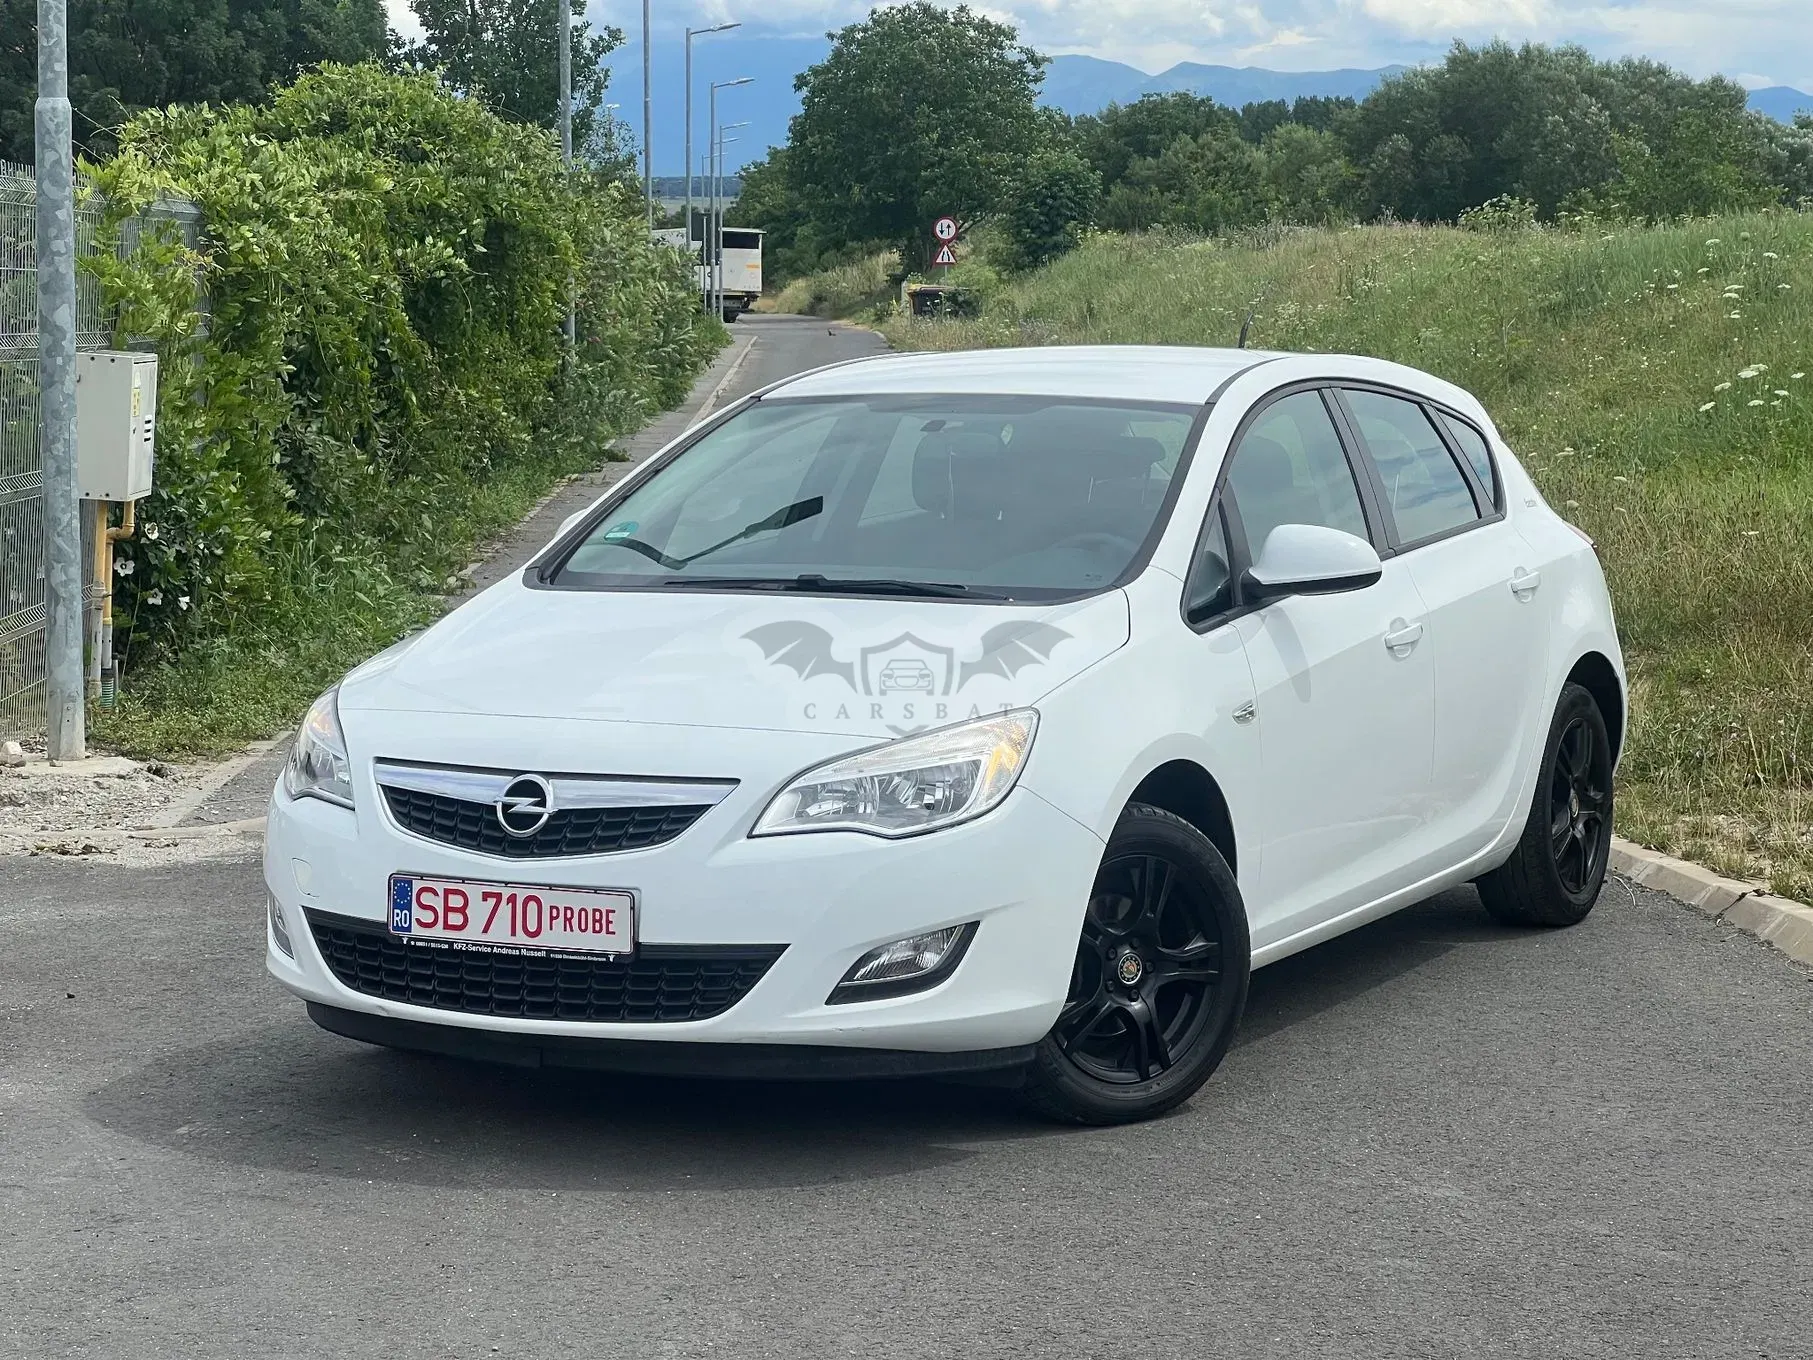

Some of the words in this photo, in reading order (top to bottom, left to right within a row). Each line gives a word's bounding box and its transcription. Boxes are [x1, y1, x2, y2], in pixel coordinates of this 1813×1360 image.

[393, 908, 410, 928] RO
[414, 886, 469, 931] SB
[481, 891, 543, 938] 710
[549, 905, 616, 935] PROBE
[453, 942, 492, 953] KFZ-Service
